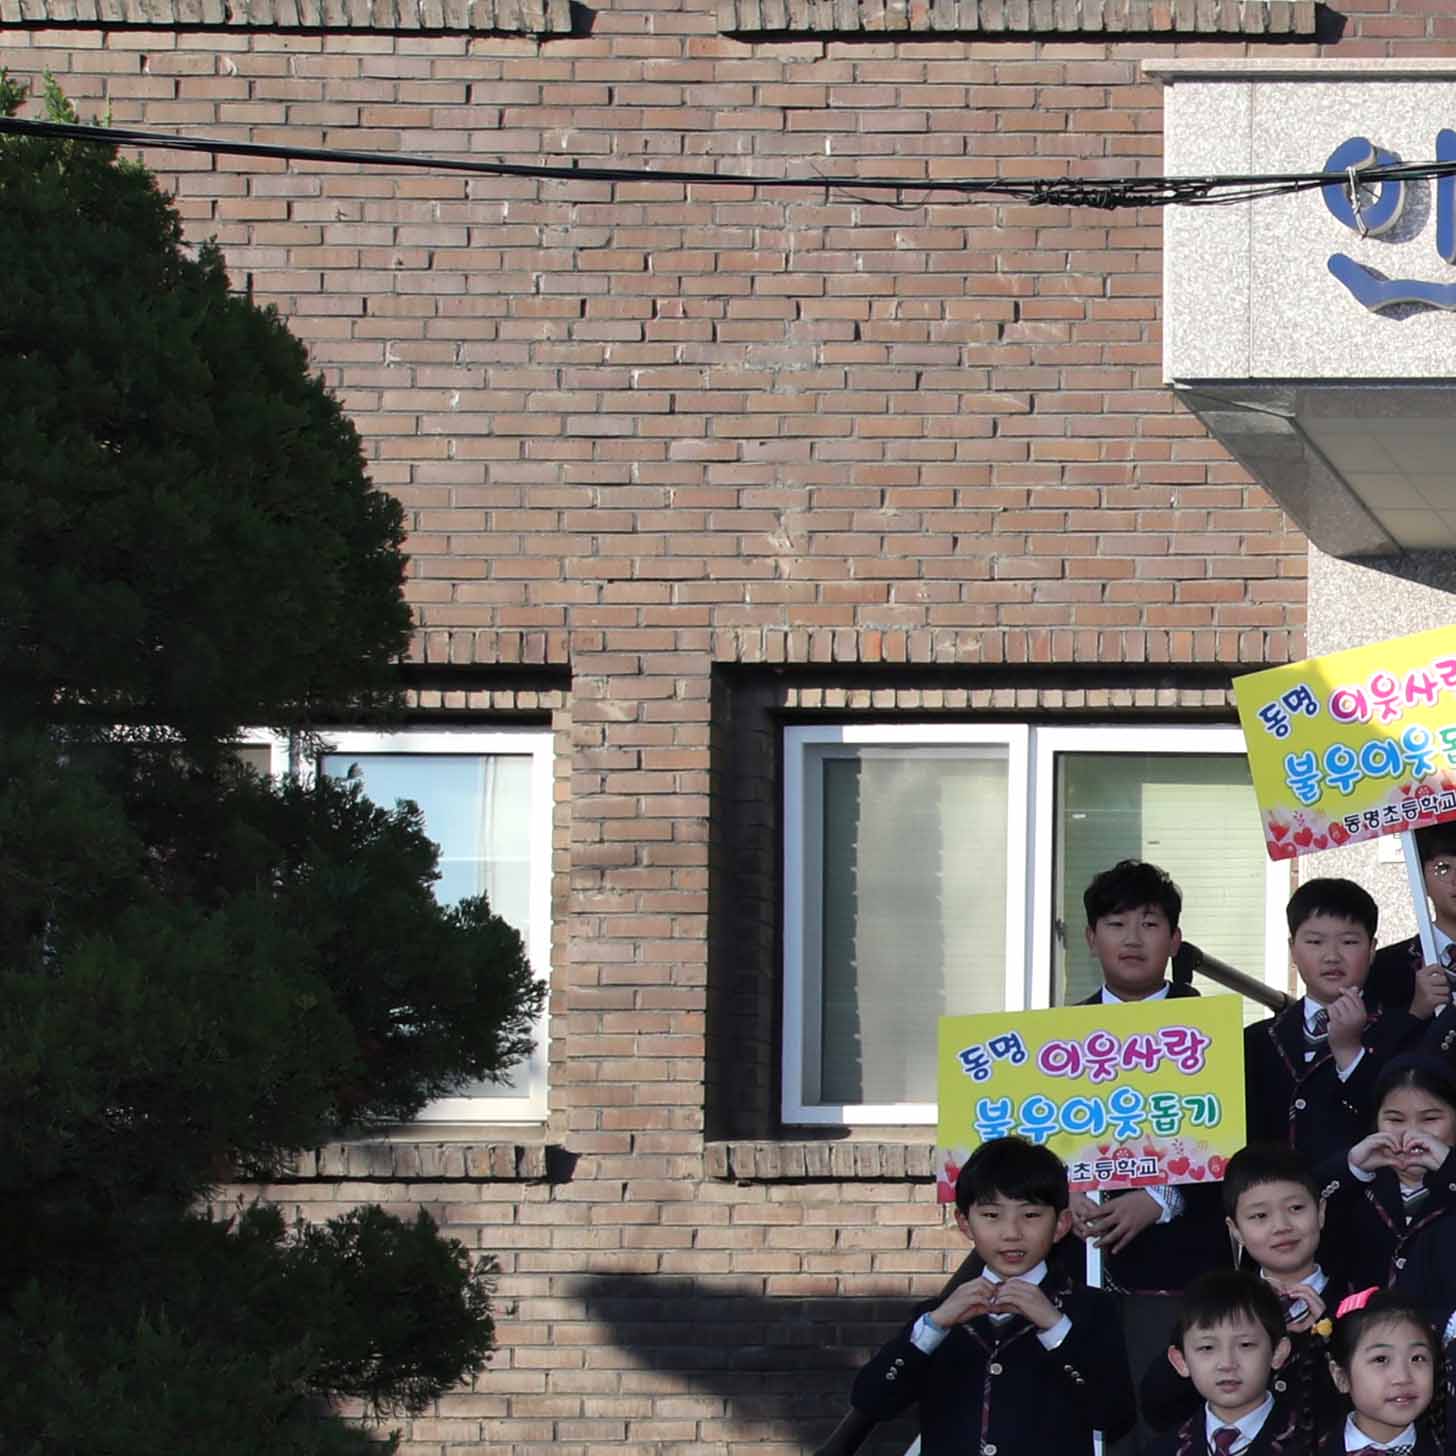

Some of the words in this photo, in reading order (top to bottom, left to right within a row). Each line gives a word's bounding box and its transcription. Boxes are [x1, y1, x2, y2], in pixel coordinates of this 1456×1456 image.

[1258, 685, 1318, 738] 동명
[959, 1032, 1027, 1081] 동명
[1040, 1028, 1209, 1079] 이웃사랑
[1072, 1157, 1158, 1181] 초등학교
